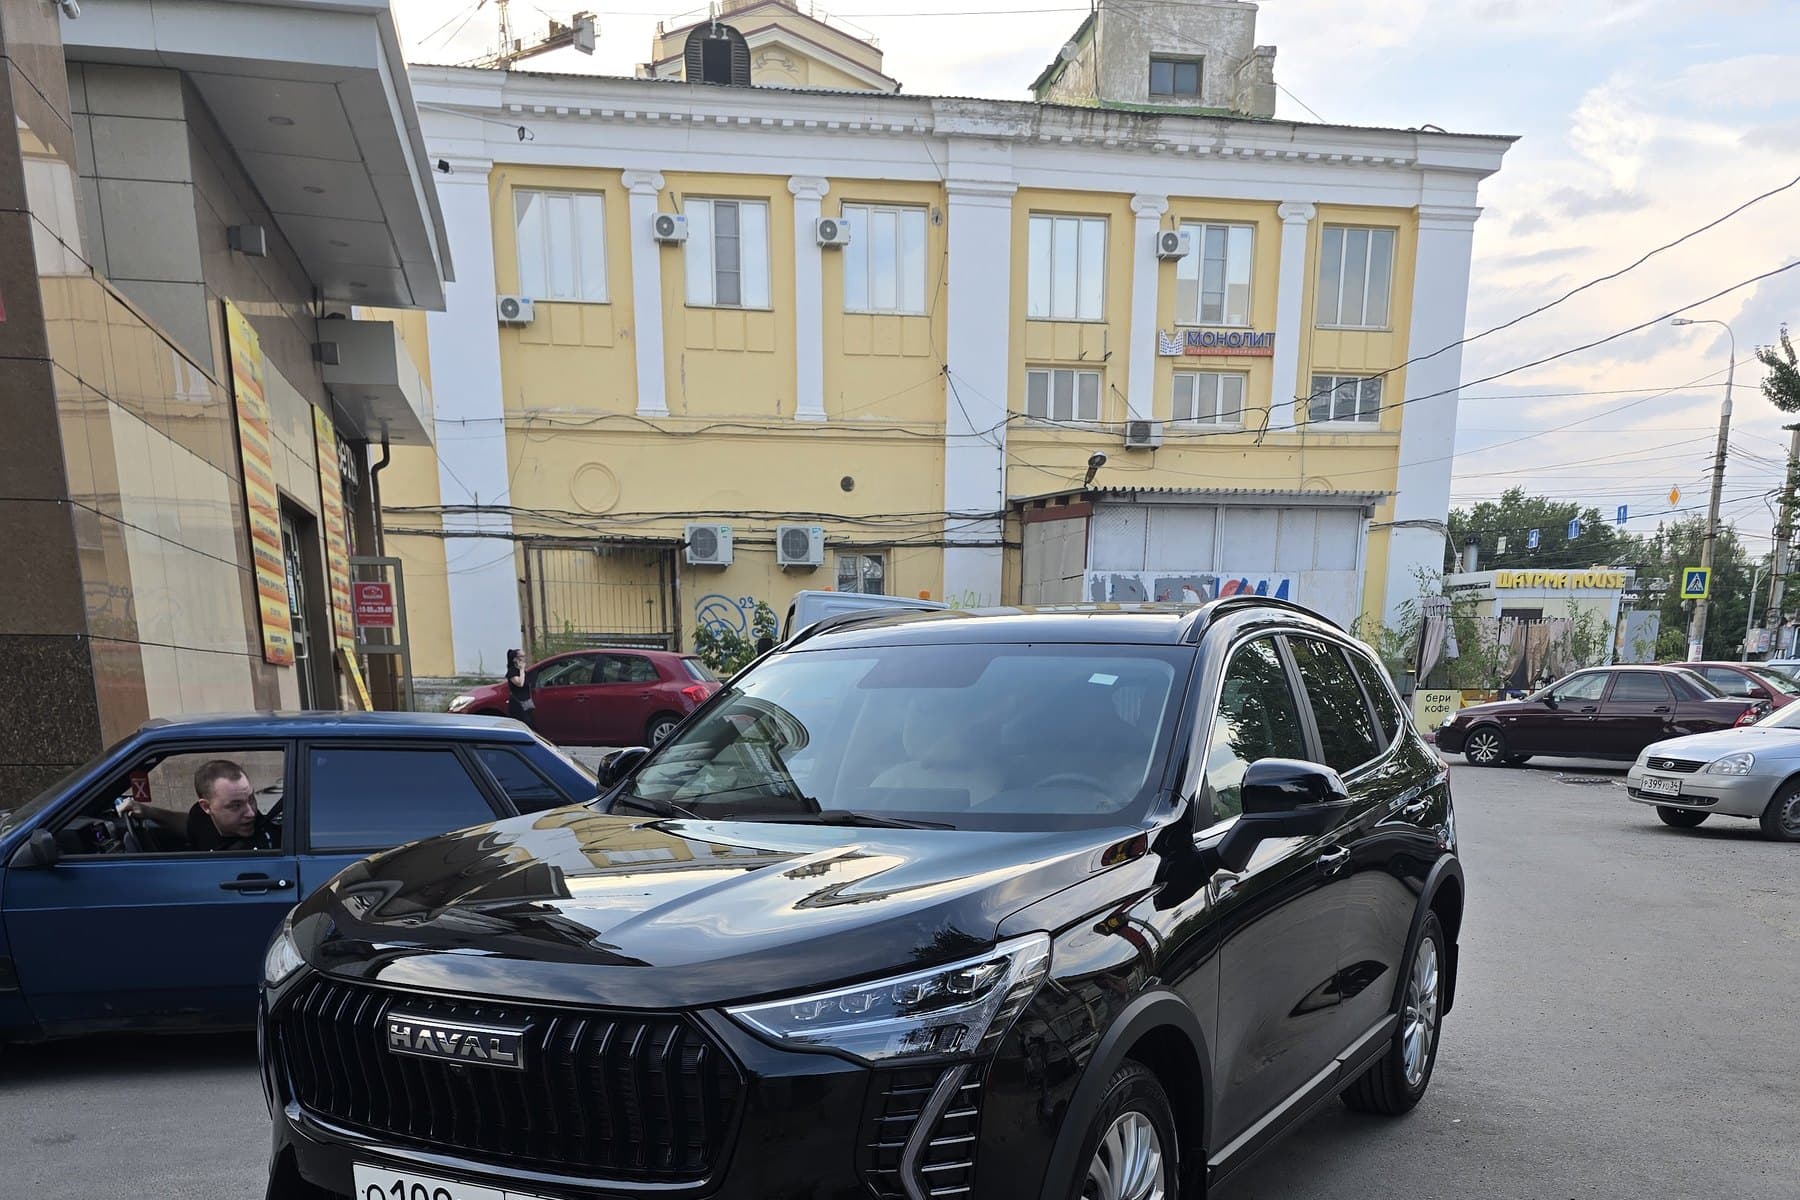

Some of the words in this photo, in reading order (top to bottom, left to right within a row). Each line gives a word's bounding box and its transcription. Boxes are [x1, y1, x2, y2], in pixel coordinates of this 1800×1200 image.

[1187, 331, 1275, 347] МОНОЛИТ
[1571, 572, 1626, 590] HOUSE
[1425, 693, 1451, 703] бери
[1424, 705, 1450, 713] кофе
[391, 1024, 514, 1061] HAVAL
